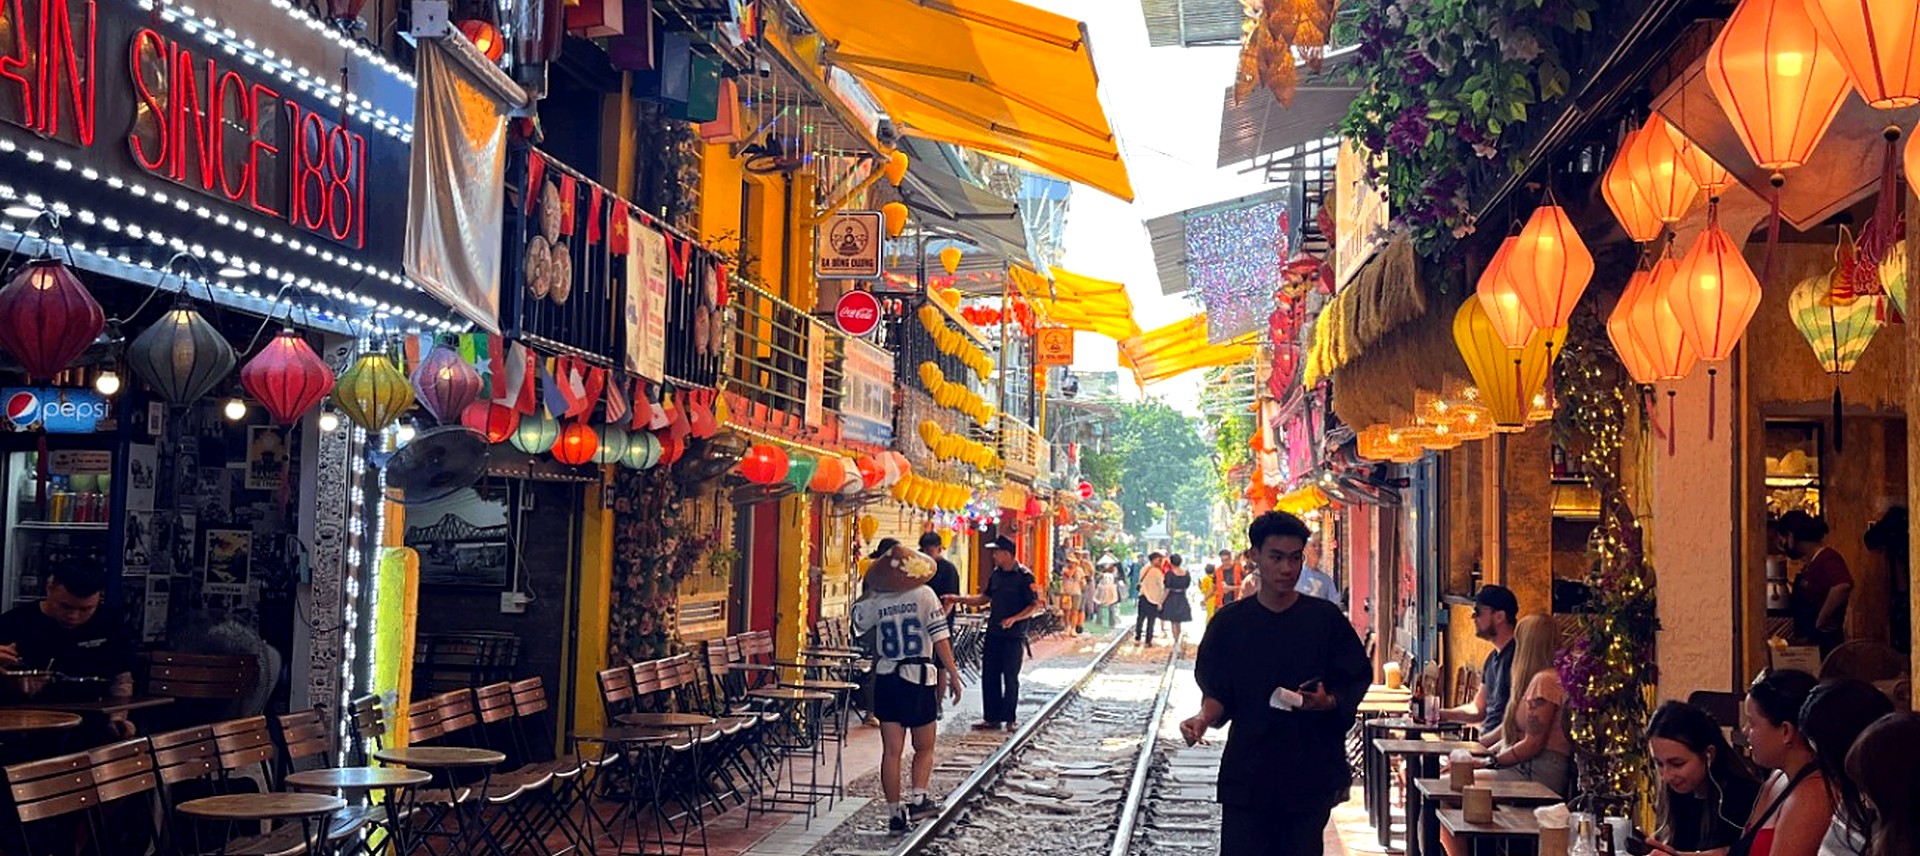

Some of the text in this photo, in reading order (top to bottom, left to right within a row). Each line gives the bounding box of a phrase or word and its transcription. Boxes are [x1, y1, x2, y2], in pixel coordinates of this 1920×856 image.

[132, 27, 280, 216] SINCE
[285, 100, 367, 250] 1881
[839, 306, 874, 319] Coca-Cola
[43, 399, 110, 421] pepsi
[880, 617, 923, 659] 86
